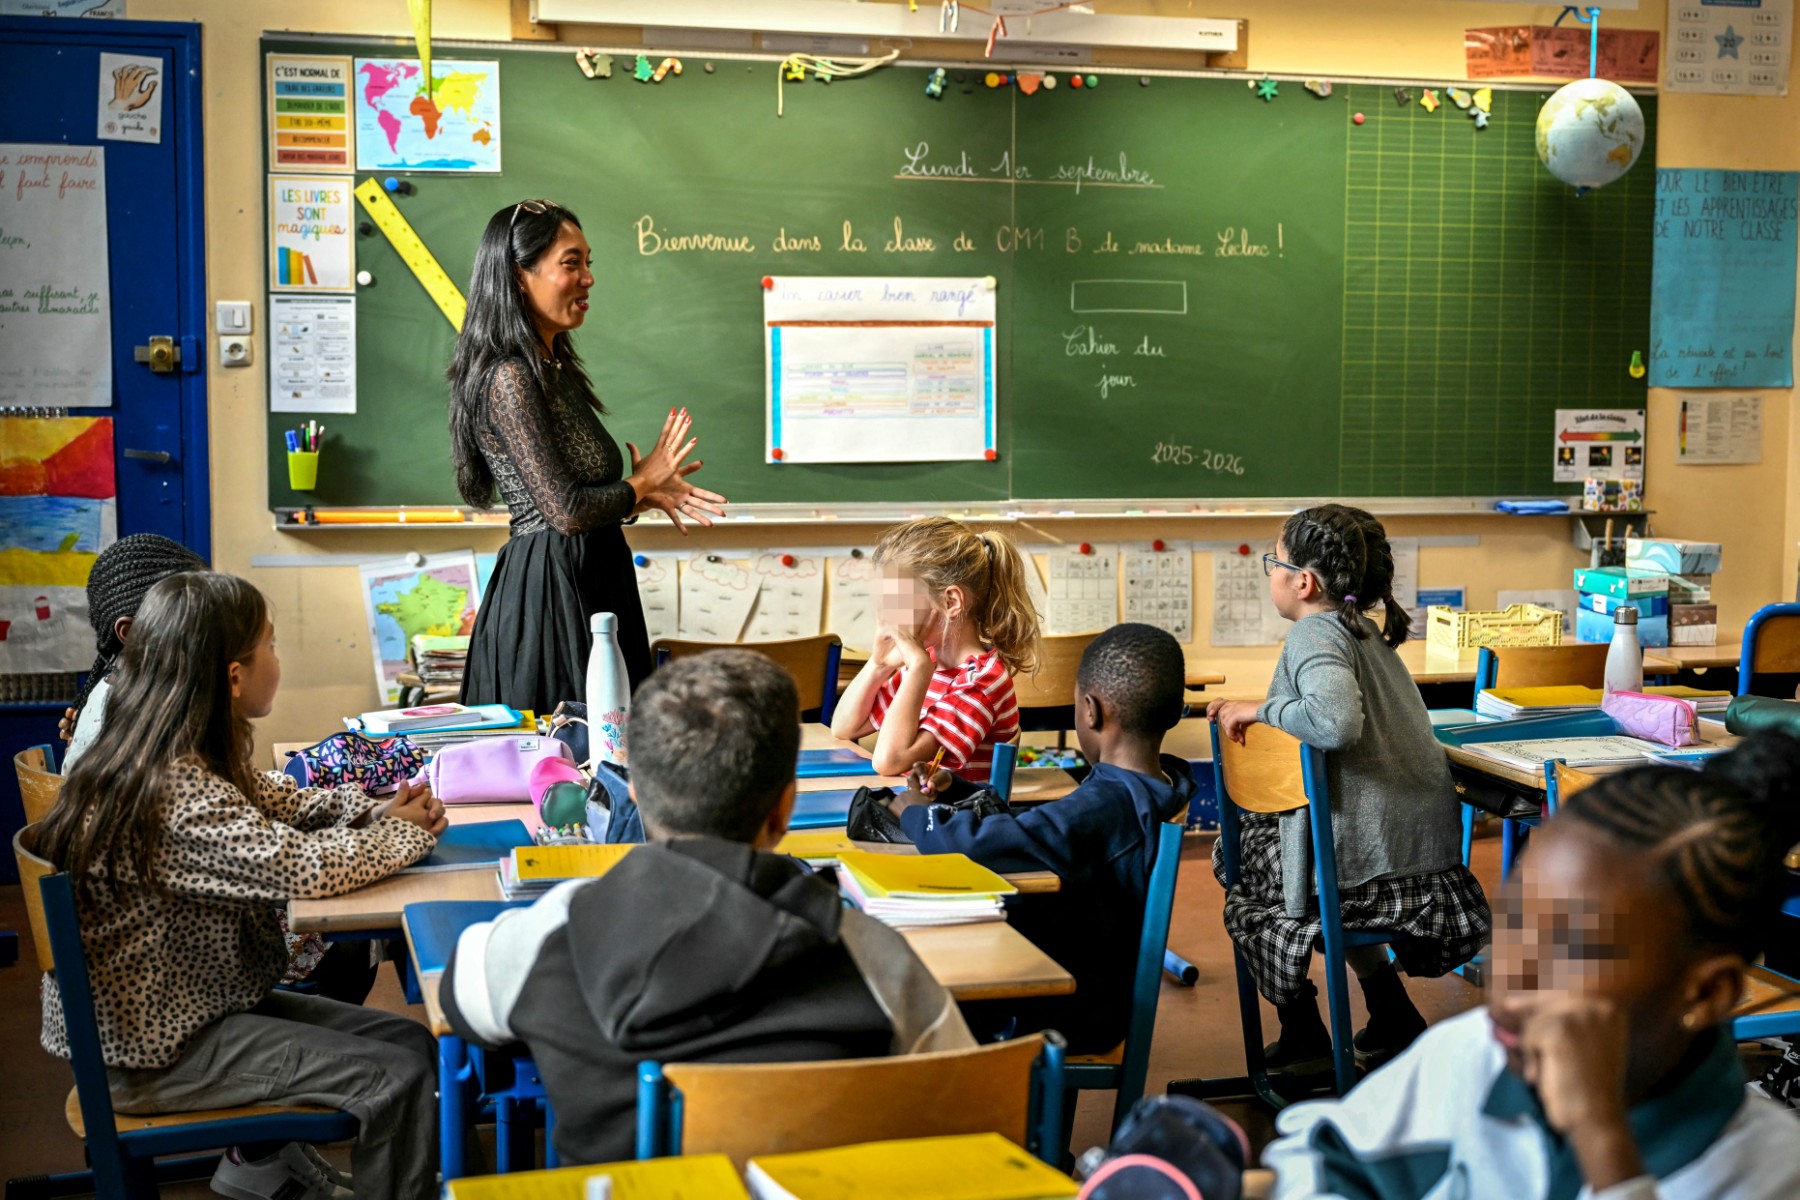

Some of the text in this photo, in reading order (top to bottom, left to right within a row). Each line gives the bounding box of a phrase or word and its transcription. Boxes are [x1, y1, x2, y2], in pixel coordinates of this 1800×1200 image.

[275, 66, 341, 78] C'EST NORMAL DE
[900, 141, 1154, 195] Lundi 1er septembre
[17, 169, 50, 201] faut
[58, 170, 97, 199] faire
[1695, 172, 1711, 193] LE
[282, 189, 341, 204] LES LIVRES
[1672, 198, 1690, 217] LES
[1700, 197, 1799, 220] APPRENTISSAGES
[297, 207, 327, 221] SONT
[278, 223, 346, 242] magiques
[632, 214, 1284, 258] Bienvenue dans la classe de CM1 B de madame Leclerc !
[1684, 219, 1725, 240] NOTRE
[1741, 220, 1784, 241] CLASSE
[880, 283, 917, 302] bien
[928, 283, 977, 317] rangé
[1062, 324, 1166, 357] Cahier du
[1094, 363, 1138, 400] jour
[1151, 441, 1246, 476] 2025-2026
